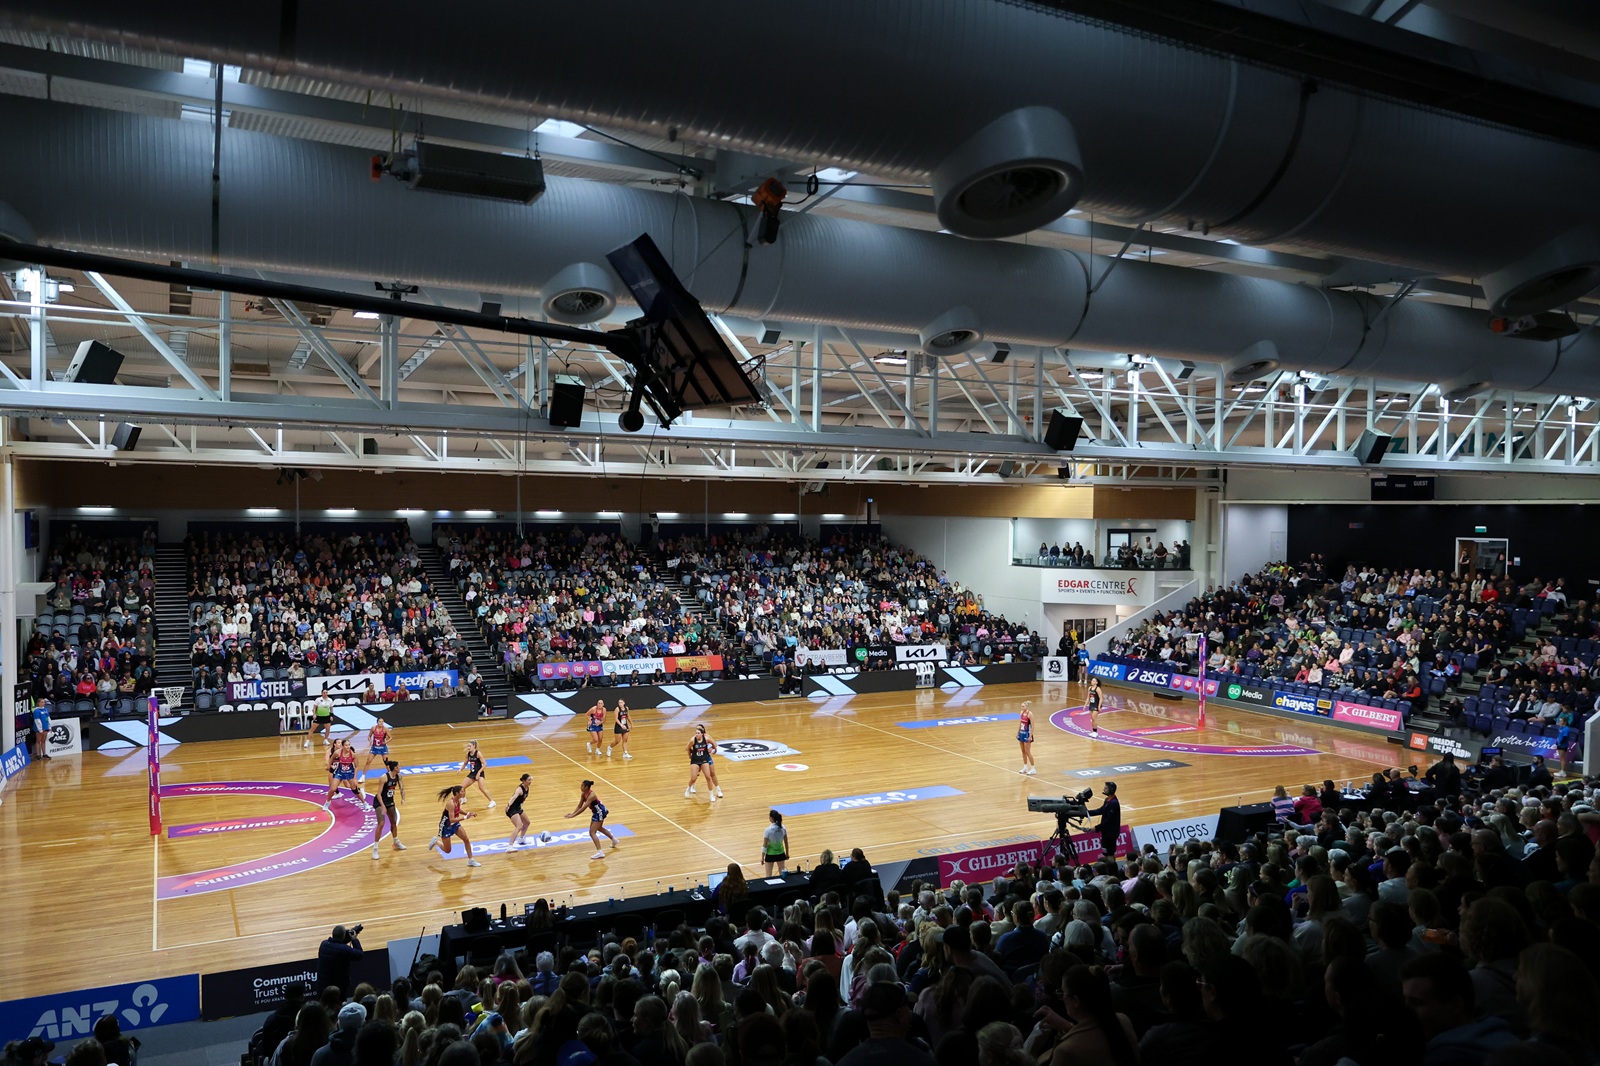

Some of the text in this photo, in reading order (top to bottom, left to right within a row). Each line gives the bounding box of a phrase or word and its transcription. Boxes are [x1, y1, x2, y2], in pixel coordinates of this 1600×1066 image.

[1058, 580, 1126, 590] EDGAR CENTRE
[906, 649, 937, 657] KIA
[619, 662, 654, 671] MERCURY
[1090, 665, 1109, 676] ANZ
[233, 683, 259, 699] REAL
[261, 681, 292, 697] STEEL
[322, 678, 371, 691] KIA
[1229, 687, 1263, 700] GO Media
[15, 699, 30, 716] REAL
[1275, 695, 1315, 711] ehayes
[1352, 708, 1397, 723] GILBERT
[16, 728, 30, 737] NEVER
[53, 734, 67, 742] ANZ
[1434, 737, 1455, 747] MADE
[1492, 735, 1521, 747] gotta
[5, 755, 20, 776] ANZ
[199, 815, 318, 834] Summerset
[1151, 823, 1209, 844] Impress
[968, 848, 1038, 871] GILBERT
[194, 857, 310, 888] Summerset
[253, 971, 318, 988] Community
[254, 986, 279, 998] Trust
[28, 1000, 119, 1039] ANZ
